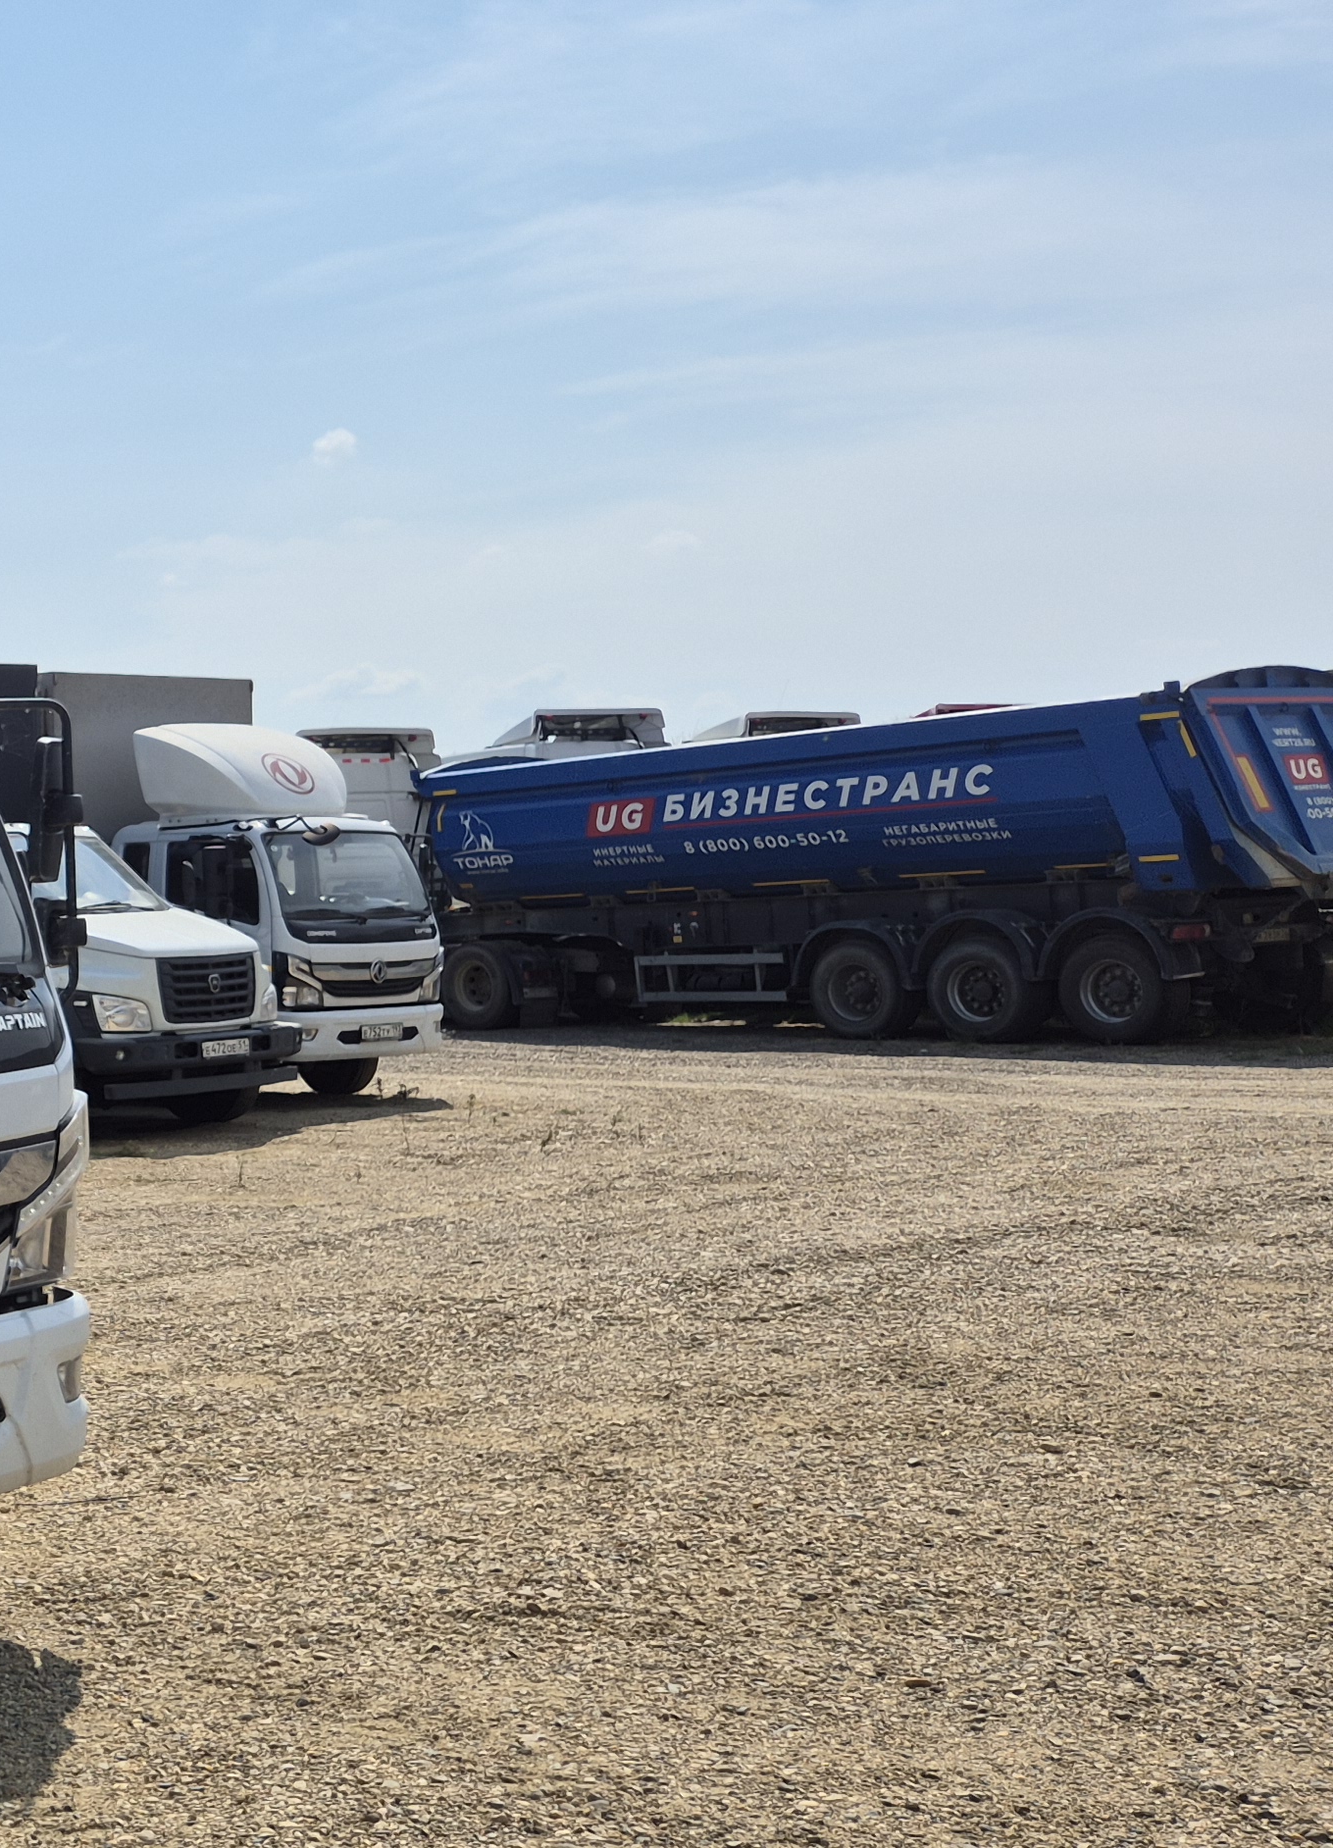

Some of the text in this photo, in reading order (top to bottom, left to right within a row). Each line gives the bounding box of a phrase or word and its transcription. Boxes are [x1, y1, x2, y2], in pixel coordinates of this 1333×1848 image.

[1289, 758, 1323, 779] UG
[595, 764, 994, 833] UG БИЗНЕСТРАНС
[1307, 807, 1333, 819] 00-5
[883, 818, 998, 836] НЕГАБАРИТНЫЕ
[684, 829, 849, 854] 8 (800) 600-50-12
[882, 830, 1012, 847] ГРУЗОПЕРЕВОЗКИ
[593, 844, 654, 857] ИНЕРТНЫЕ
[453, 854, 513, 869] ТОНАР
[593, 855, 665, 867] МАТЕРИАЛЫ
